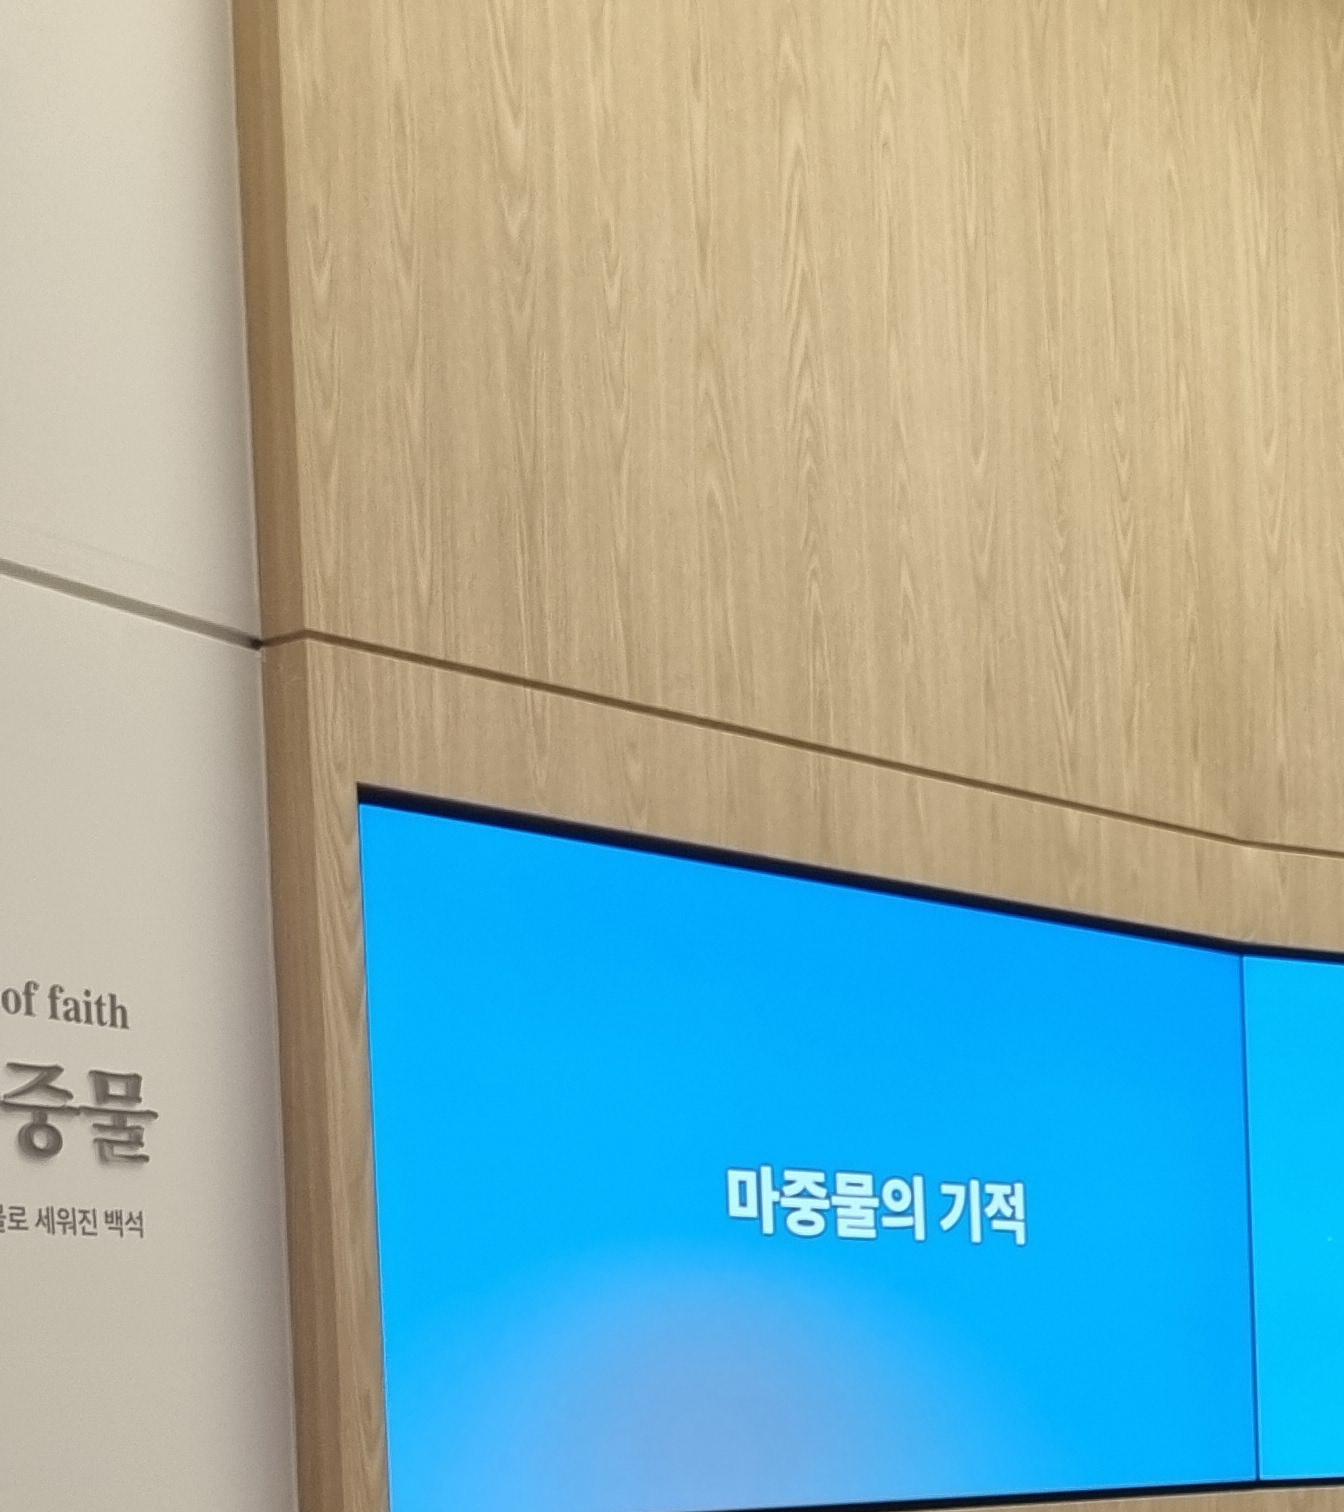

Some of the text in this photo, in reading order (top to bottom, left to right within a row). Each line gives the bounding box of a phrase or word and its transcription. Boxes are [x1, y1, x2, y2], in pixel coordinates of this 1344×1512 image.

[1, 980, 130, 1030] of faith
[1, 1062, 159, 1162] 중물
[0, 1203, 145, 1239] 로 세워진 백석
[727, 1165, 1027, 1246] 마중물의 기적
